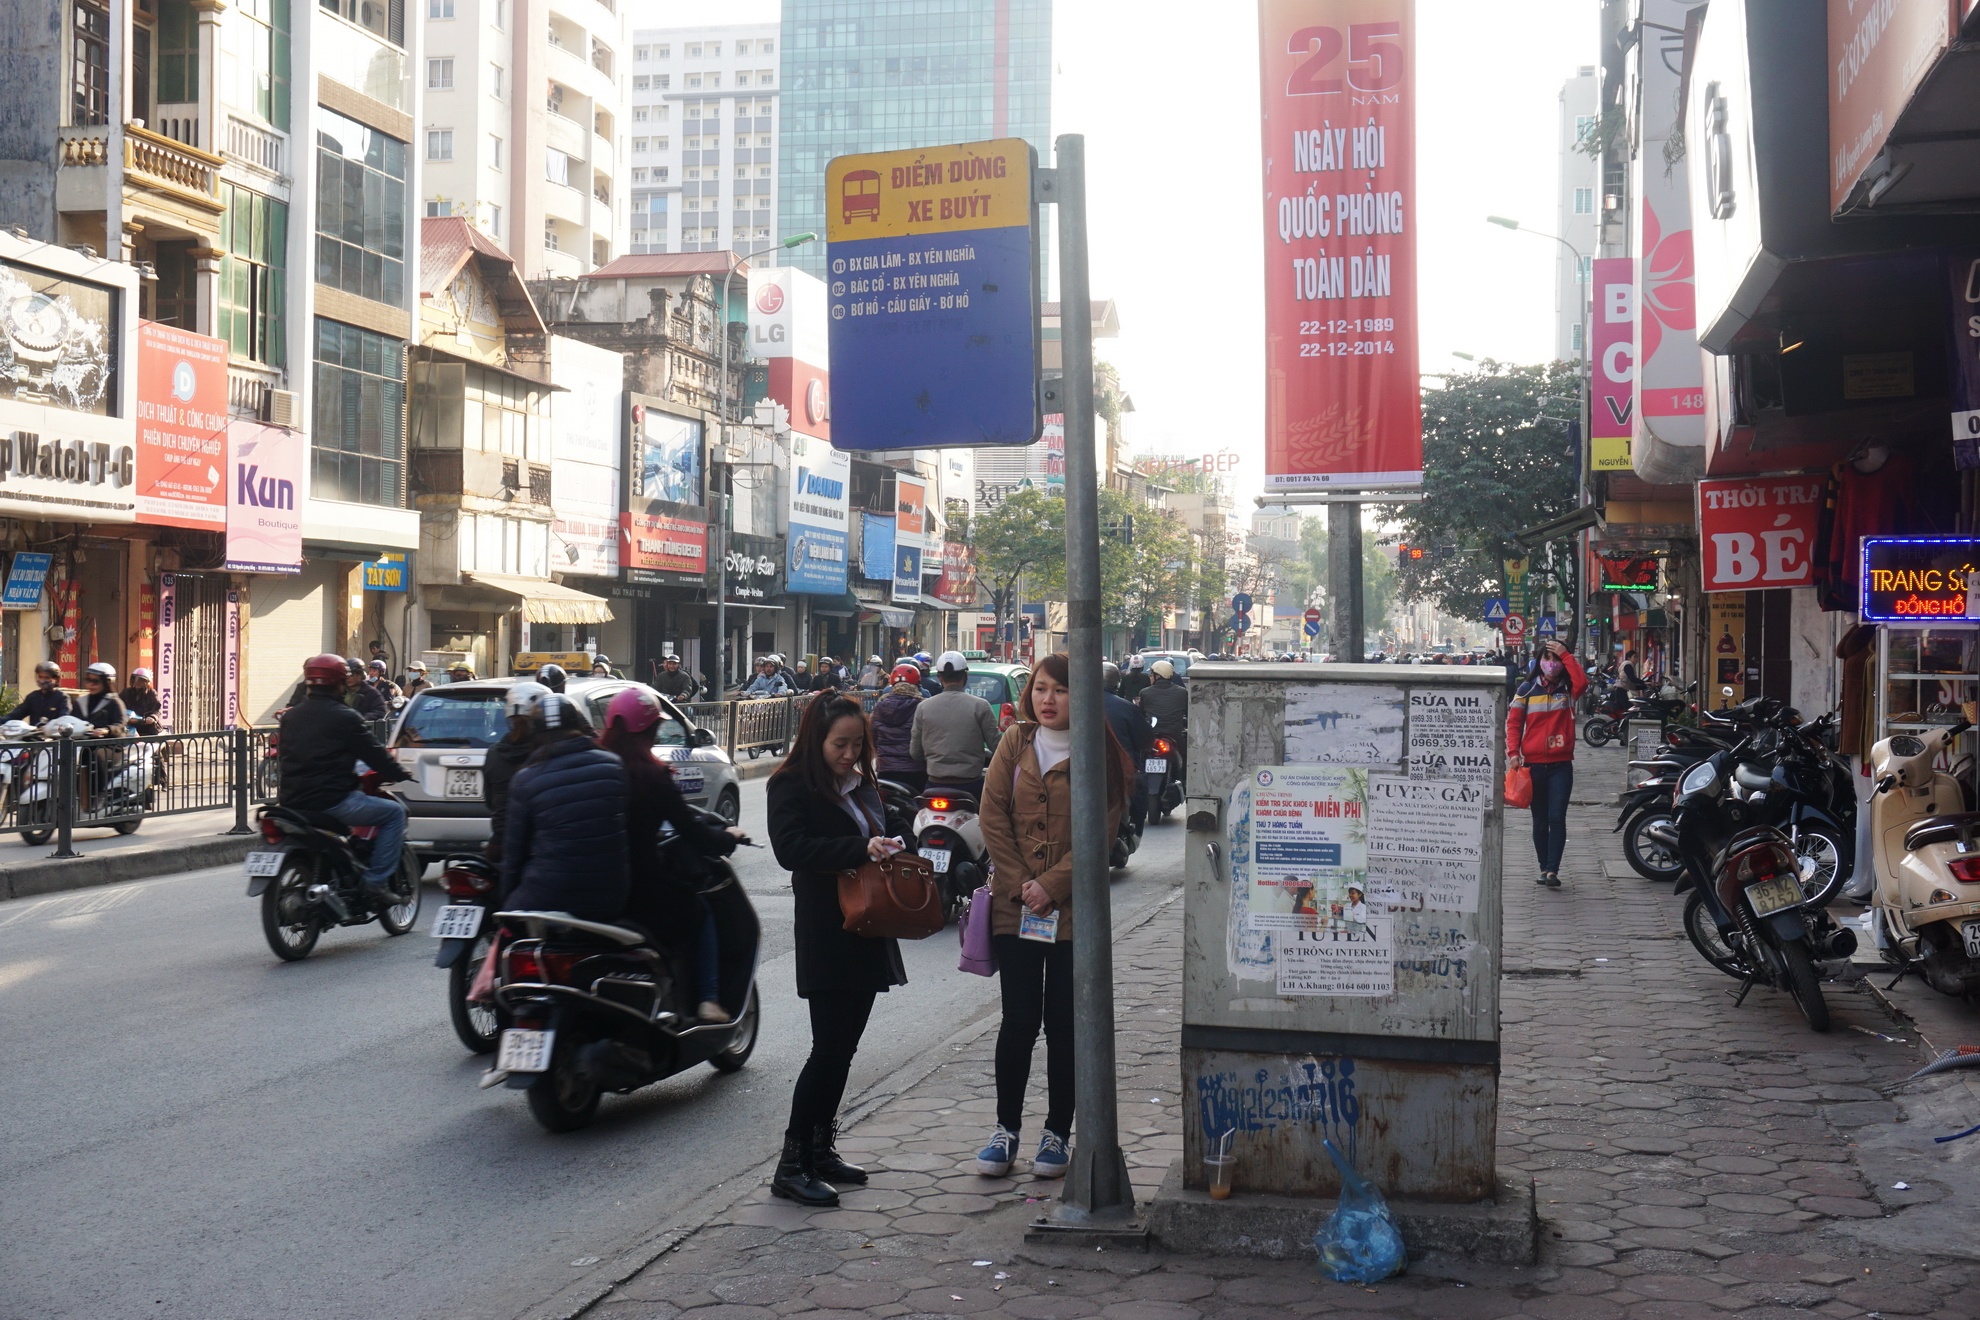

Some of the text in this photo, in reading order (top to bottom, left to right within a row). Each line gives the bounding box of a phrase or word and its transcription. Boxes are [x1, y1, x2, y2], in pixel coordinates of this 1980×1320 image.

[1861, 2, 1880, 64] SINH
[1286, 20, 1404, 97] 25
[1351, 93, 1400, 106] NĂM
[1294, 117, 1385, 178] NGÀY HỘI
[891, 151, 1006, 189] ĐIỂM DỪNG
[1835, 143, 1847, 190] 144
[907, 188, 992, 223] XE BUÝT
[1278, 180, 1403, 244] QUỐC PHÒNG
[834, 261, 845, 272] 01
[850, 257, 862, 271] BX
[863, 255, 878, 270] GIA
[908, 252, 921, 266] BX
[924, 247, 943, 265] YÊN
[945, 244, 976, 263] NGHĨA
[834, 269, 960, 295] 02 BÁC CỔ BX YÊN NGHĨA
[1293, 246, 1391, 300] TOÀN DÂN
[834, 289, 969, 317] 09 BỜ HỒ CẦU GIẤY BỜ HỒ
[755, 323, 785, 344] LG
[1299, 317, 1395, 335] 22-12-1989
[1299, 340, 1395, 357] 22-12-2014
[1671, 394, 1704, 409] 148
[138, 401, 154, 420] DỊCH
[156, 403, 177, 426] THUẬT
[179, 409, 185, 426] &
[187, 408, 204, 429] CÔNG
[143, 428, 161, 447] PHIÊN
[162, 431, 176, 451] DỊCH
[201, 440, 222, 457] NGHIỆP
[17, 430, 91, 482] Watch
[632, 424, 643, 497] INTERIOR
[1203, 446, 1240, 473] BẾP
[1598, 455, 1630, 466] NGUYỄN
[237, 463, 294, 510] Kun
[807, 474, 844, 500] DAIKIN
[1706, 483, 1767, 509] THỜI
[258, 518, 299, 531] Boutique
[568, 521, 587, 536] KHOA
[588, 523, 601, 538] THU
[637, 537, 664, 554] THANH
[681, 543, 702, 558] DECOR
[1412, 549, 1423, 559] 99
[1711, 513, 1809, 584] BÉ
[725, 549, 756, 581] Ngọc
[755, 554, 776, 576] Lan
[1508, 572, 1521, 584] 70
[164, 576, 174, 585] 135
[1870, 569, 1943, 592] TRANG
[165, 595, 174, 627] Kun
[1895, 594, 1965, 614] ĐỒNG HỒ
[163, 643, 172, 675] Kun
[229, 652, 237, 680] Kun
[162, 689, 171, 720] Kun
[229, 692, 237, 719] Kun
[1411, 692, 1448, 707] SỬA
[1410, 751, 1492, 766] SỬA NHÀ
[1256, 797, 1269, 806] KIỂM
[1281, 798, 1293, 807] SỨC
[1256, 808, 1272, 816] KHÁM
[1288, 809, 1302, 817] BỆNH
[1313, 795, 1362, 818] MIỄN PHÍ
[1256, 820, 1267, 828] THỨ
[1272, 820, 1288, 829] HÀNG
[1288, 821, 1303, 829] TUẦN
[1370, 841, 1461, 854] LH C. Hoa: 0167 6655
[1752, 876, 1793, 900] 36-N2
[1283, 945, 1389, 957] 05 TRÔNG INTERNET
[1283, 981, 1295, 989] LH
[1297, 982, 1335, 991] A.Khang:
[1336, 982, 1355, 990] 0164
[1372, 983, 1390, 991] 1103
